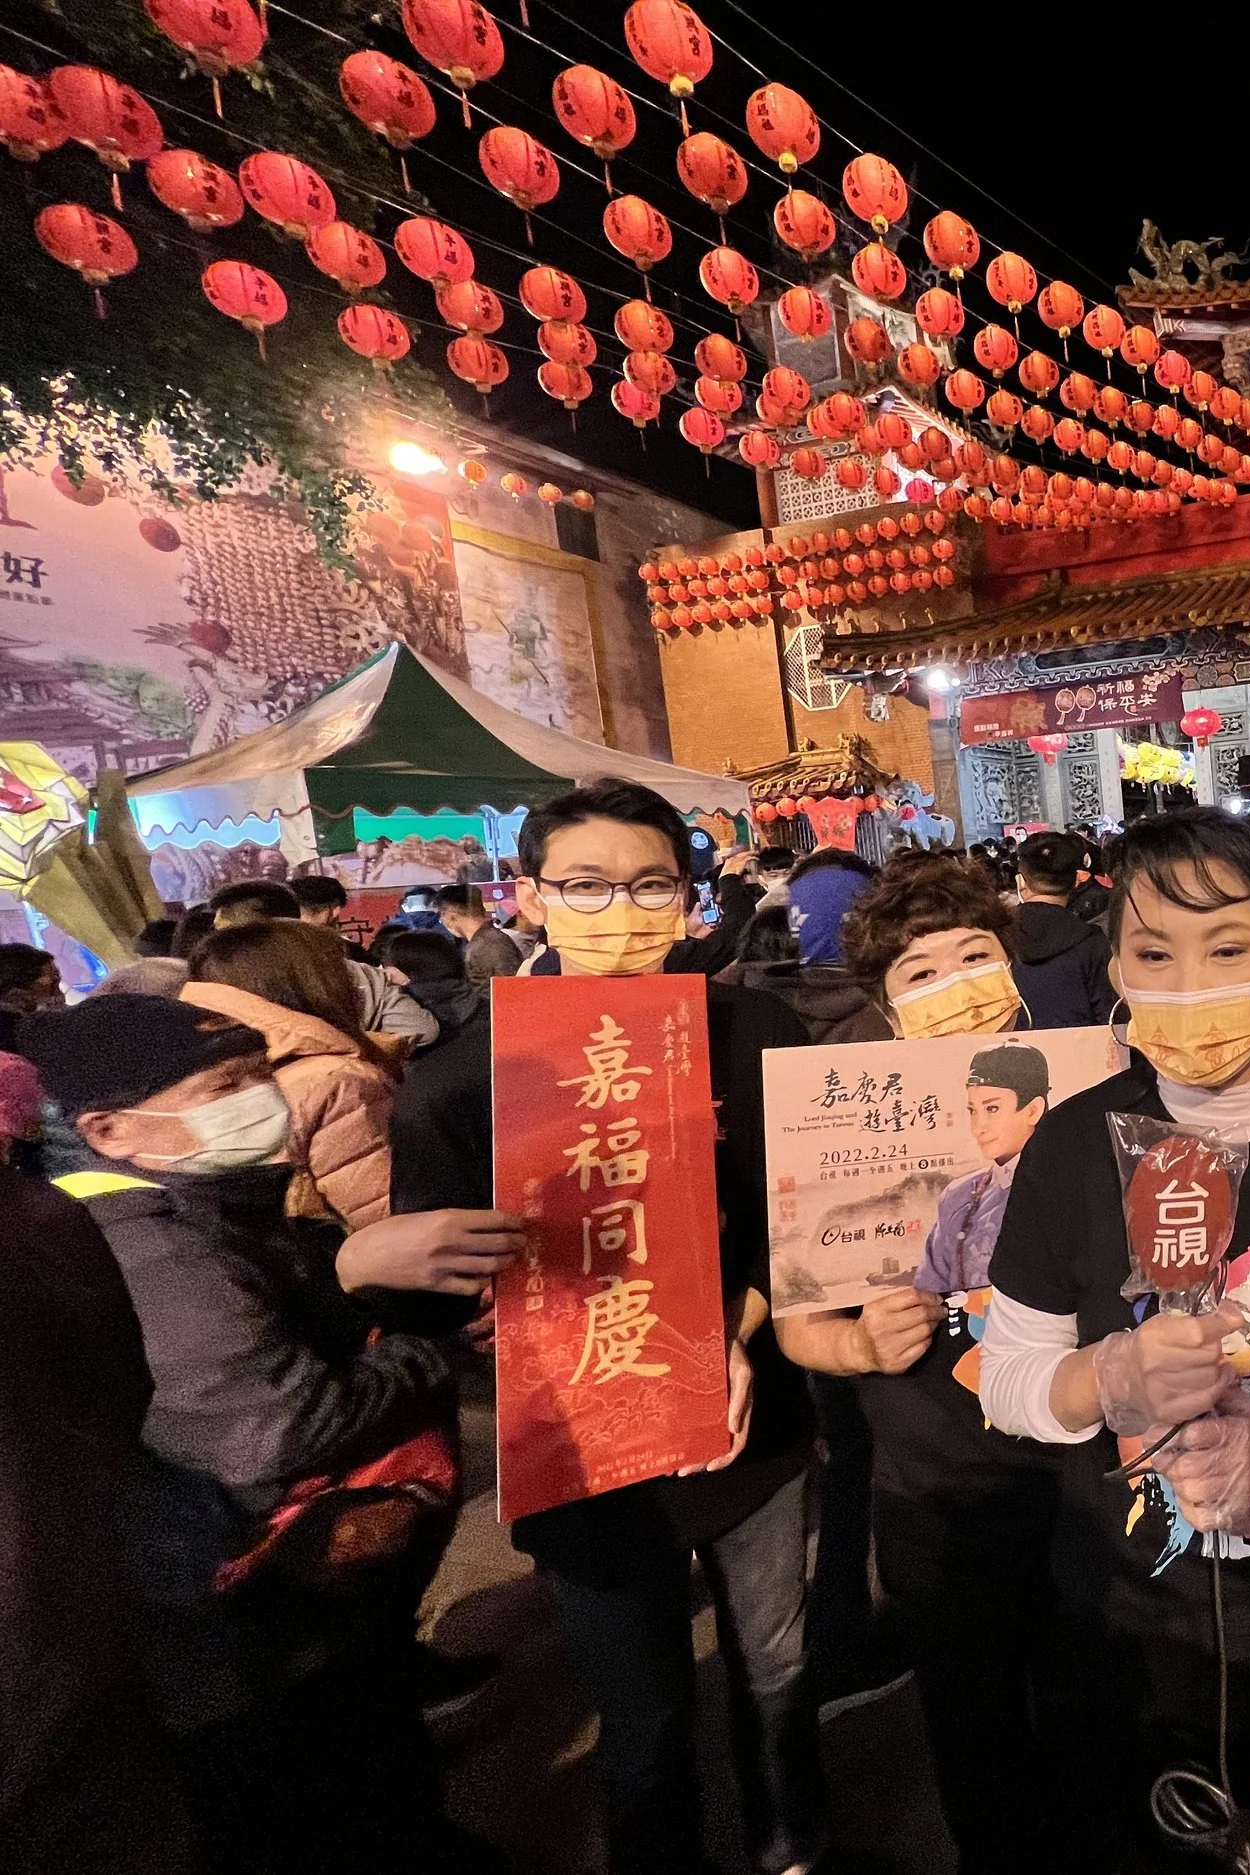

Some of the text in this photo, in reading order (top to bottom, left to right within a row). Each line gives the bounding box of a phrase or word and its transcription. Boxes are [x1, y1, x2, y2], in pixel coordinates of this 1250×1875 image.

[810, 1067, 904, 1108] 嘉慶君
[859, 1094, 942, 1134] 遊臺灣
[819, 1143, 909, 1165] 2022.2.24
[556, 1014, 671, 1386] 嘉福同慶
[840, 1230, 867, 1244] 台視
[1151, 1179, 1211, 1269] 台視
